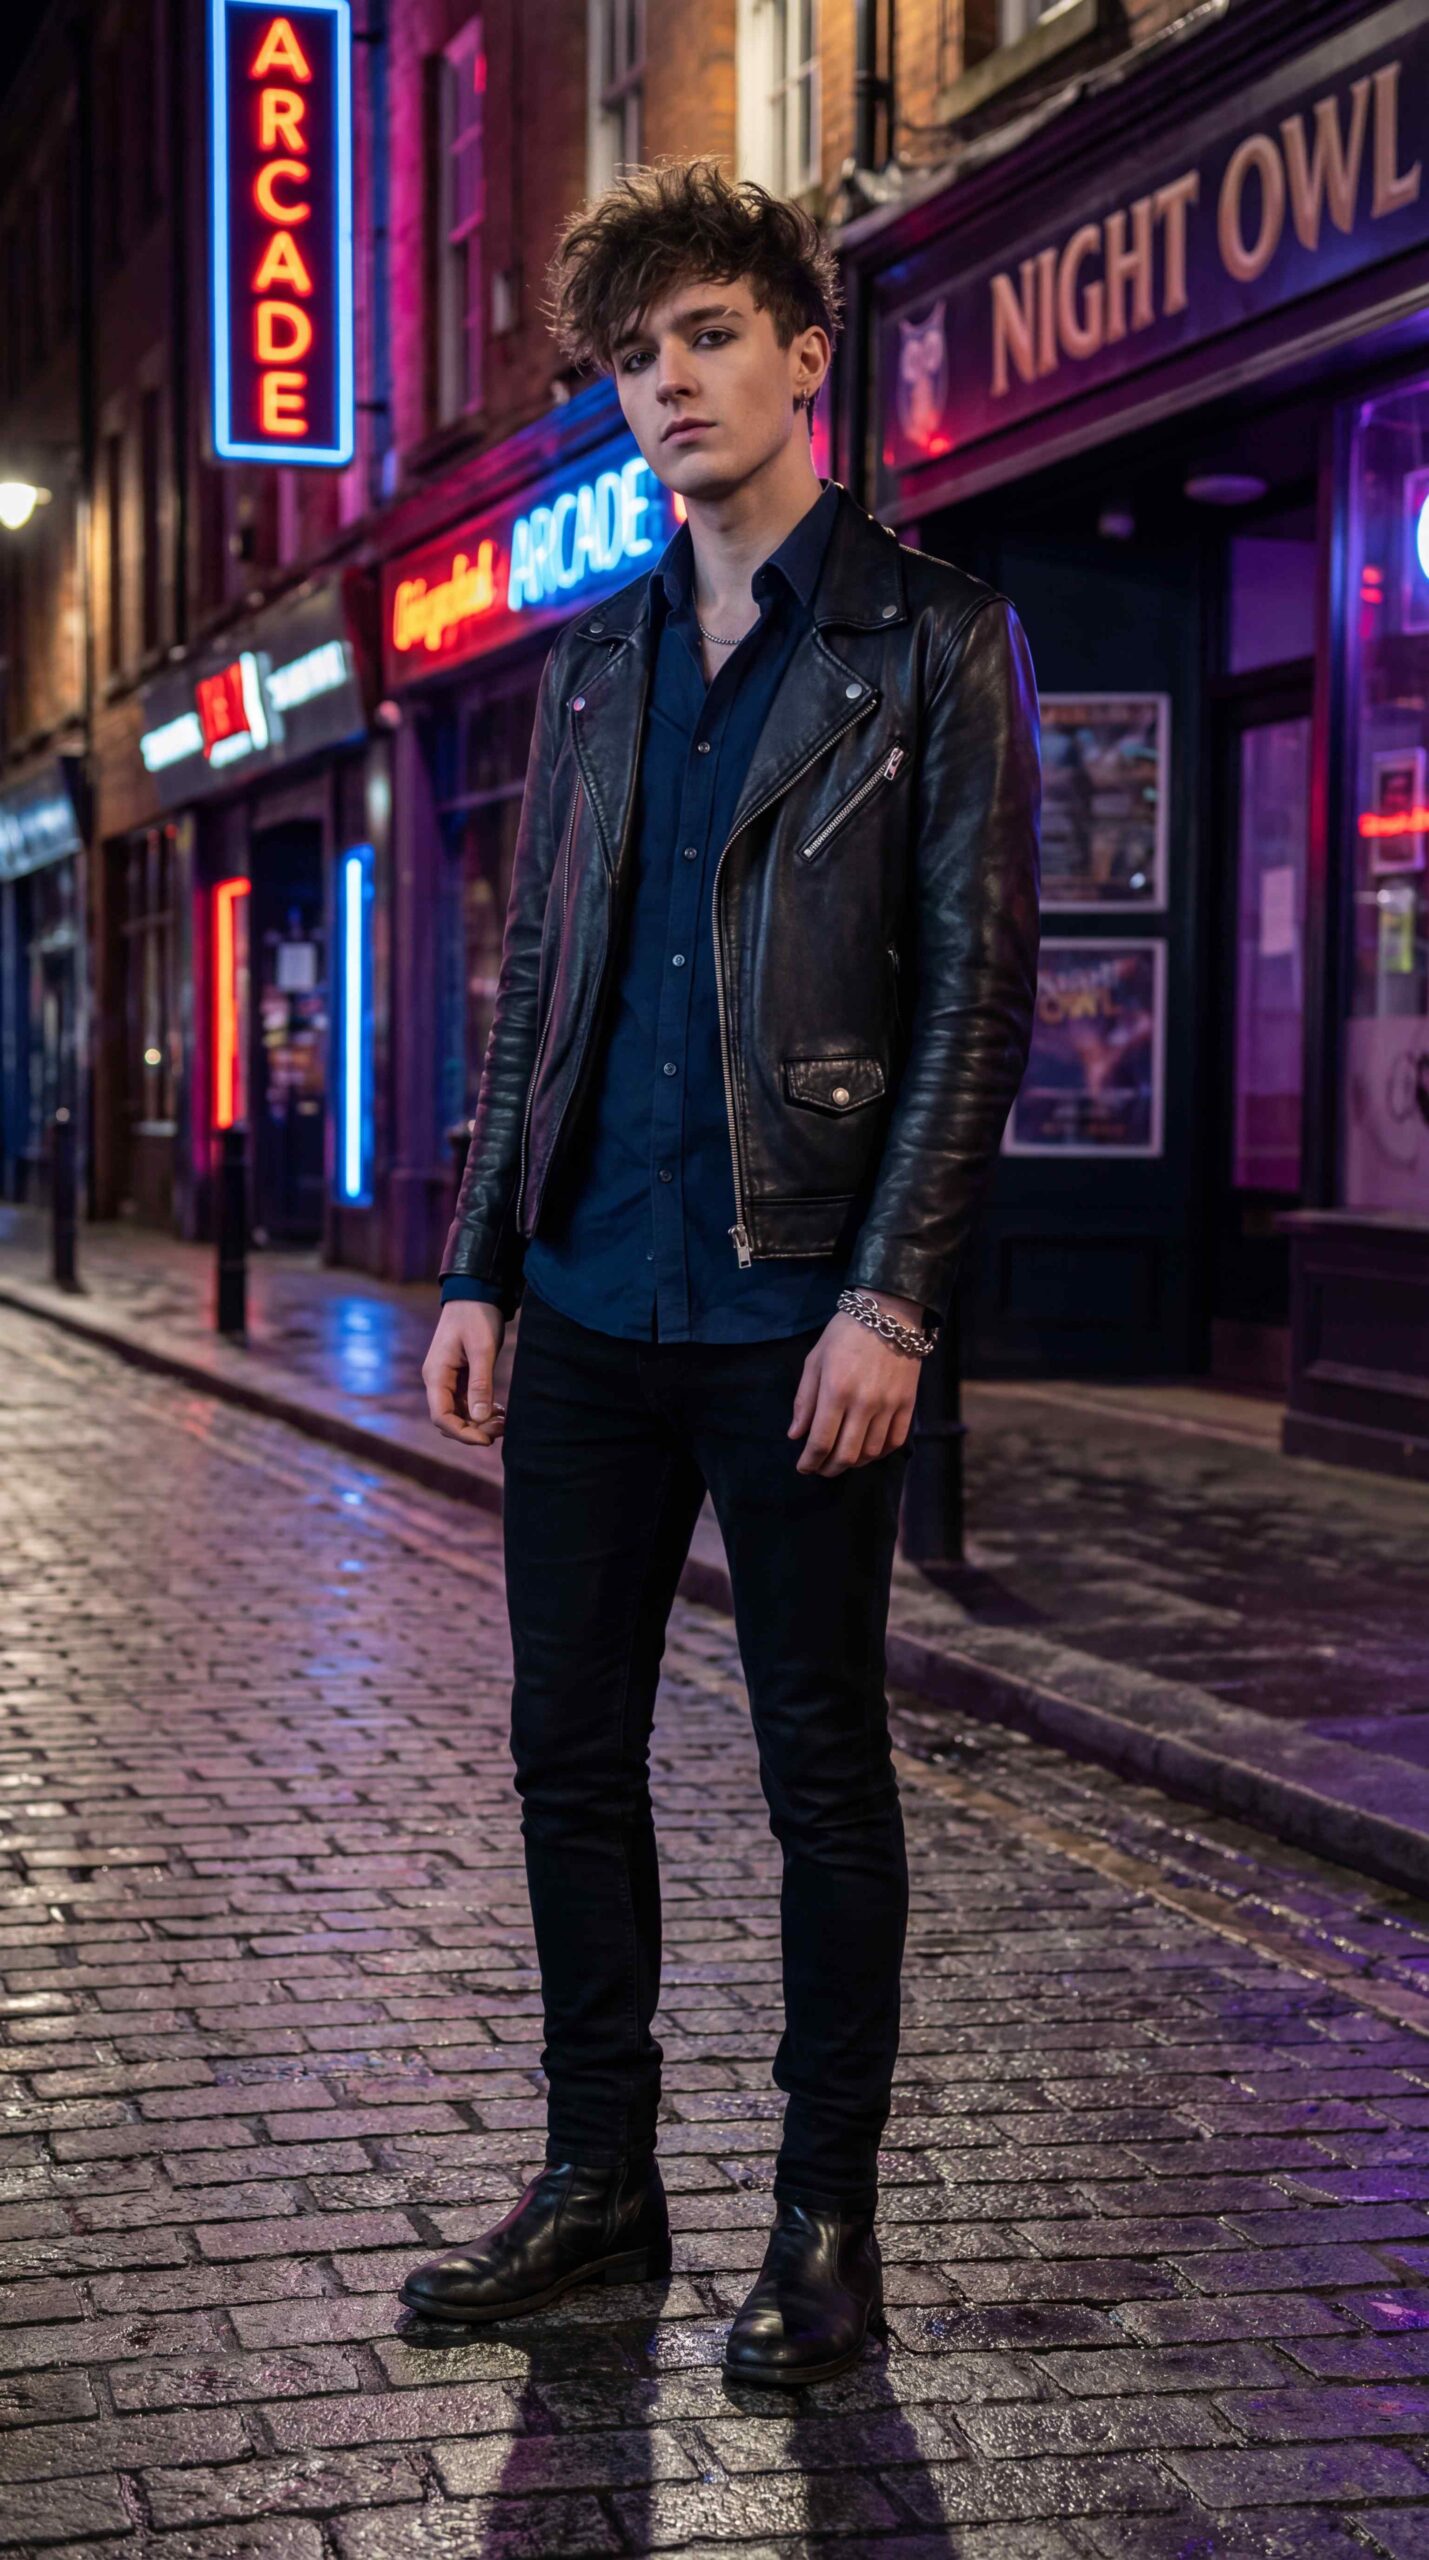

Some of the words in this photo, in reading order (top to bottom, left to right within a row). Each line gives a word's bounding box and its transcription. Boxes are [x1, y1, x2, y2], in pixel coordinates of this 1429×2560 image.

[250, 17, 313, 437] ARCADE
[989, 169, 1200, 398] NIGHT
[1216, 60, 1423, 284] OWL
[507, 456, 653, 613] ARCADE
